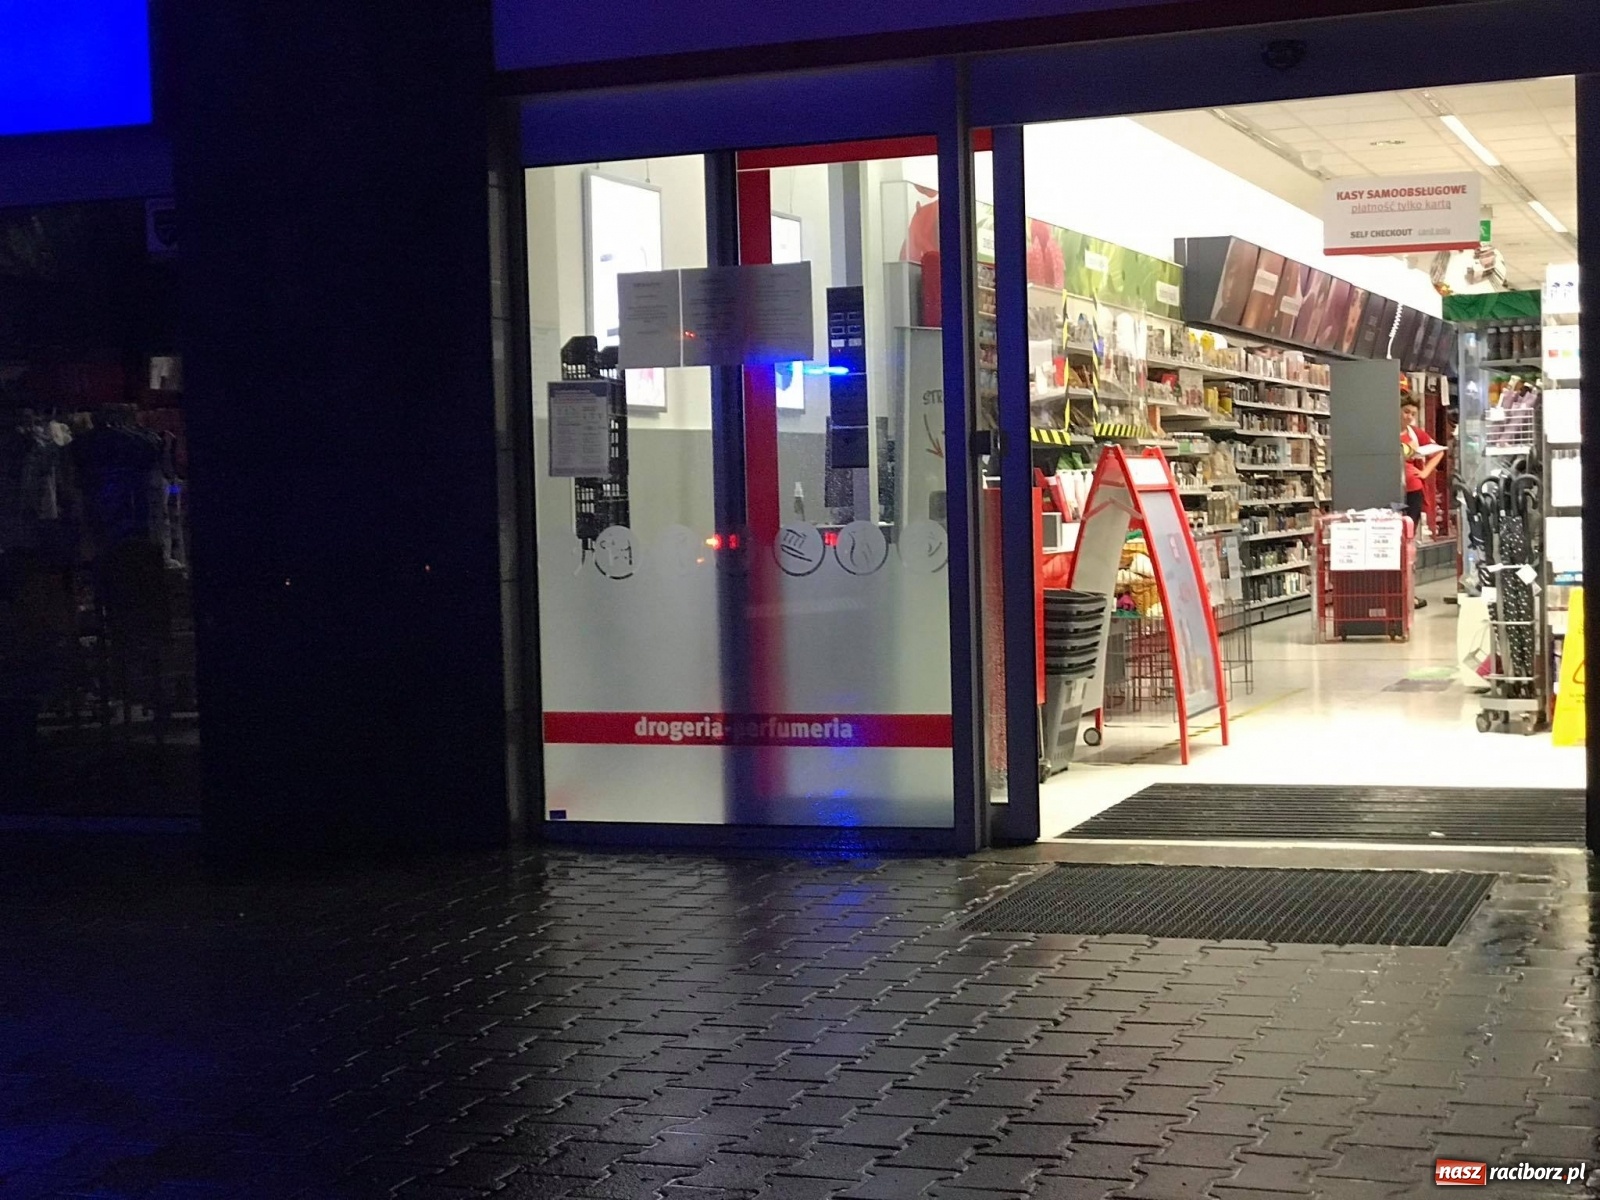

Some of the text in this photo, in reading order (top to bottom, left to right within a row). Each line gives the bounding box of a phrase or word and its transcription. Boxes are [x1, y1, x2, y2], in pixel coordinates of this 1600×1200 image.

[1336, 184, 1467, 201] KASY SAMOOBSŁUGOWE
[1397, 200, 1422, 212] tylko
[1350, 229, 1368, 239] SELF
[1370, 228, 1412, 238] CHECKOUT
